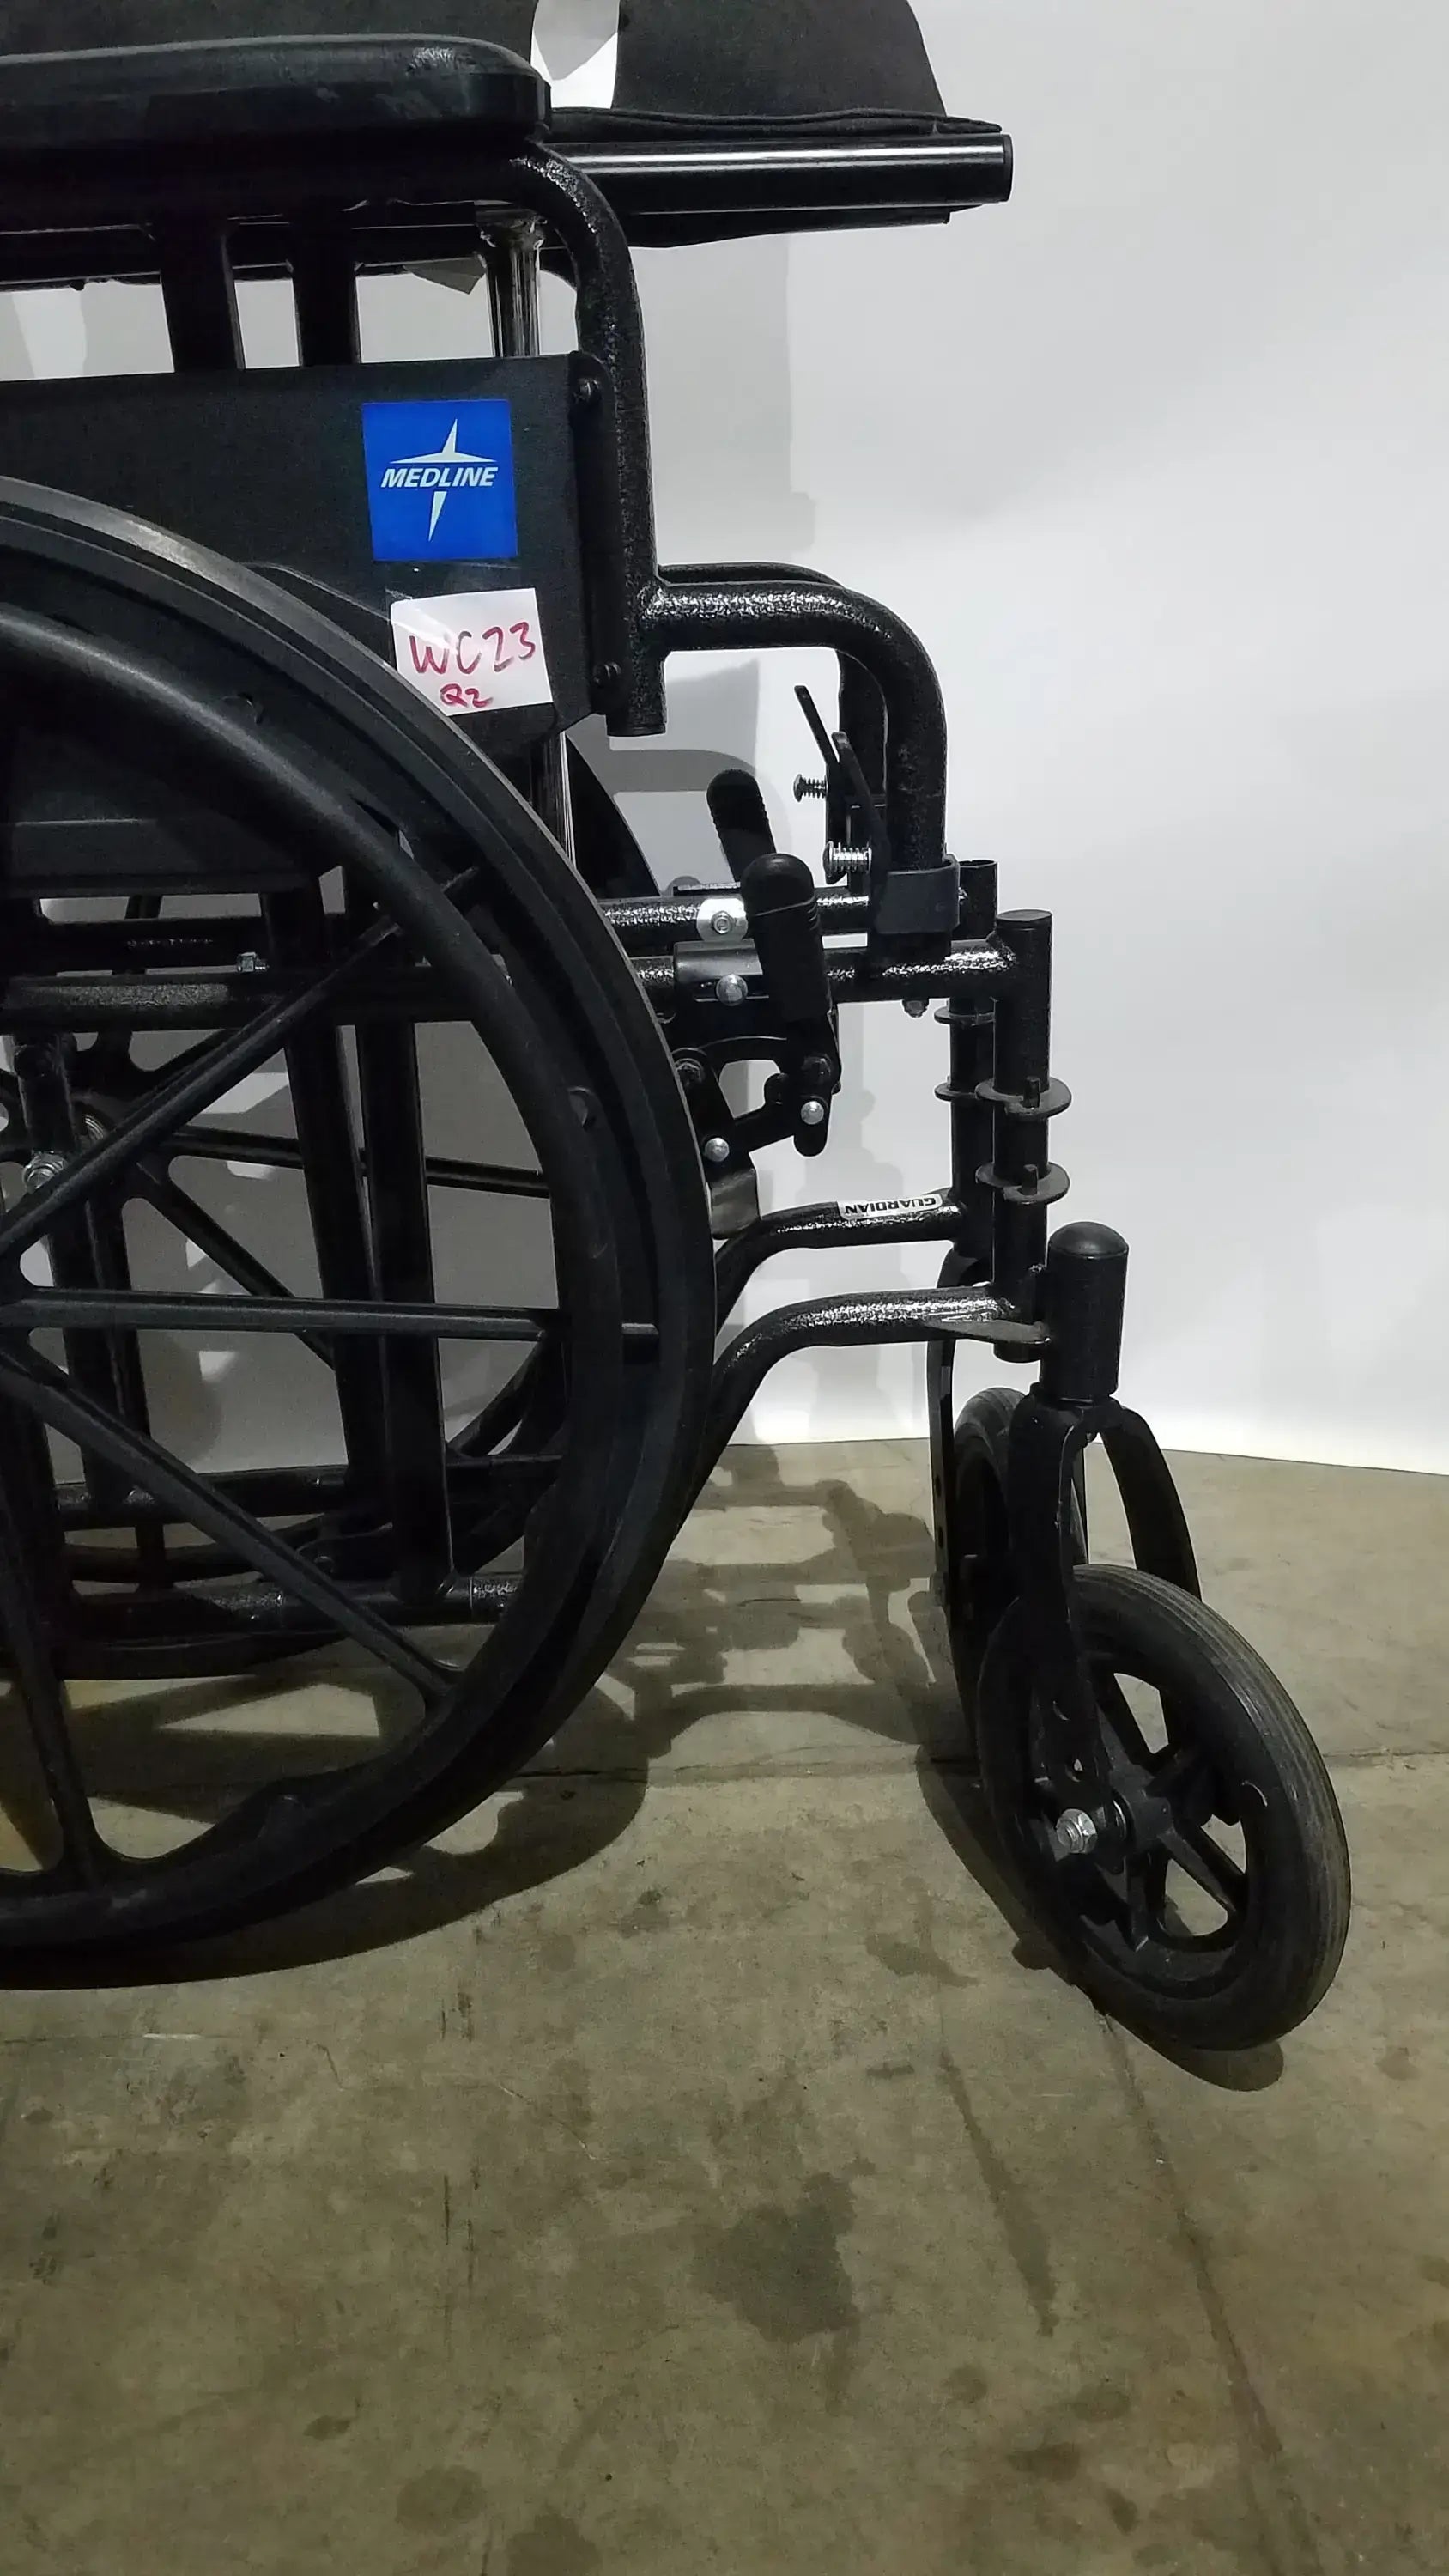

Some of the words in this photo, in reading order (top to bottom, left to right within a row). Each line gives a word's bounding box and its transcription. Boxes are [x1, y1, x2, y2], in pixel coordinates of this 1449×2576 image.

[381, 466, 498, 488] MEDLINE
[409, 621, 536, 674] WC23
[845, 1197, 937, 1215] GUARDIAN
